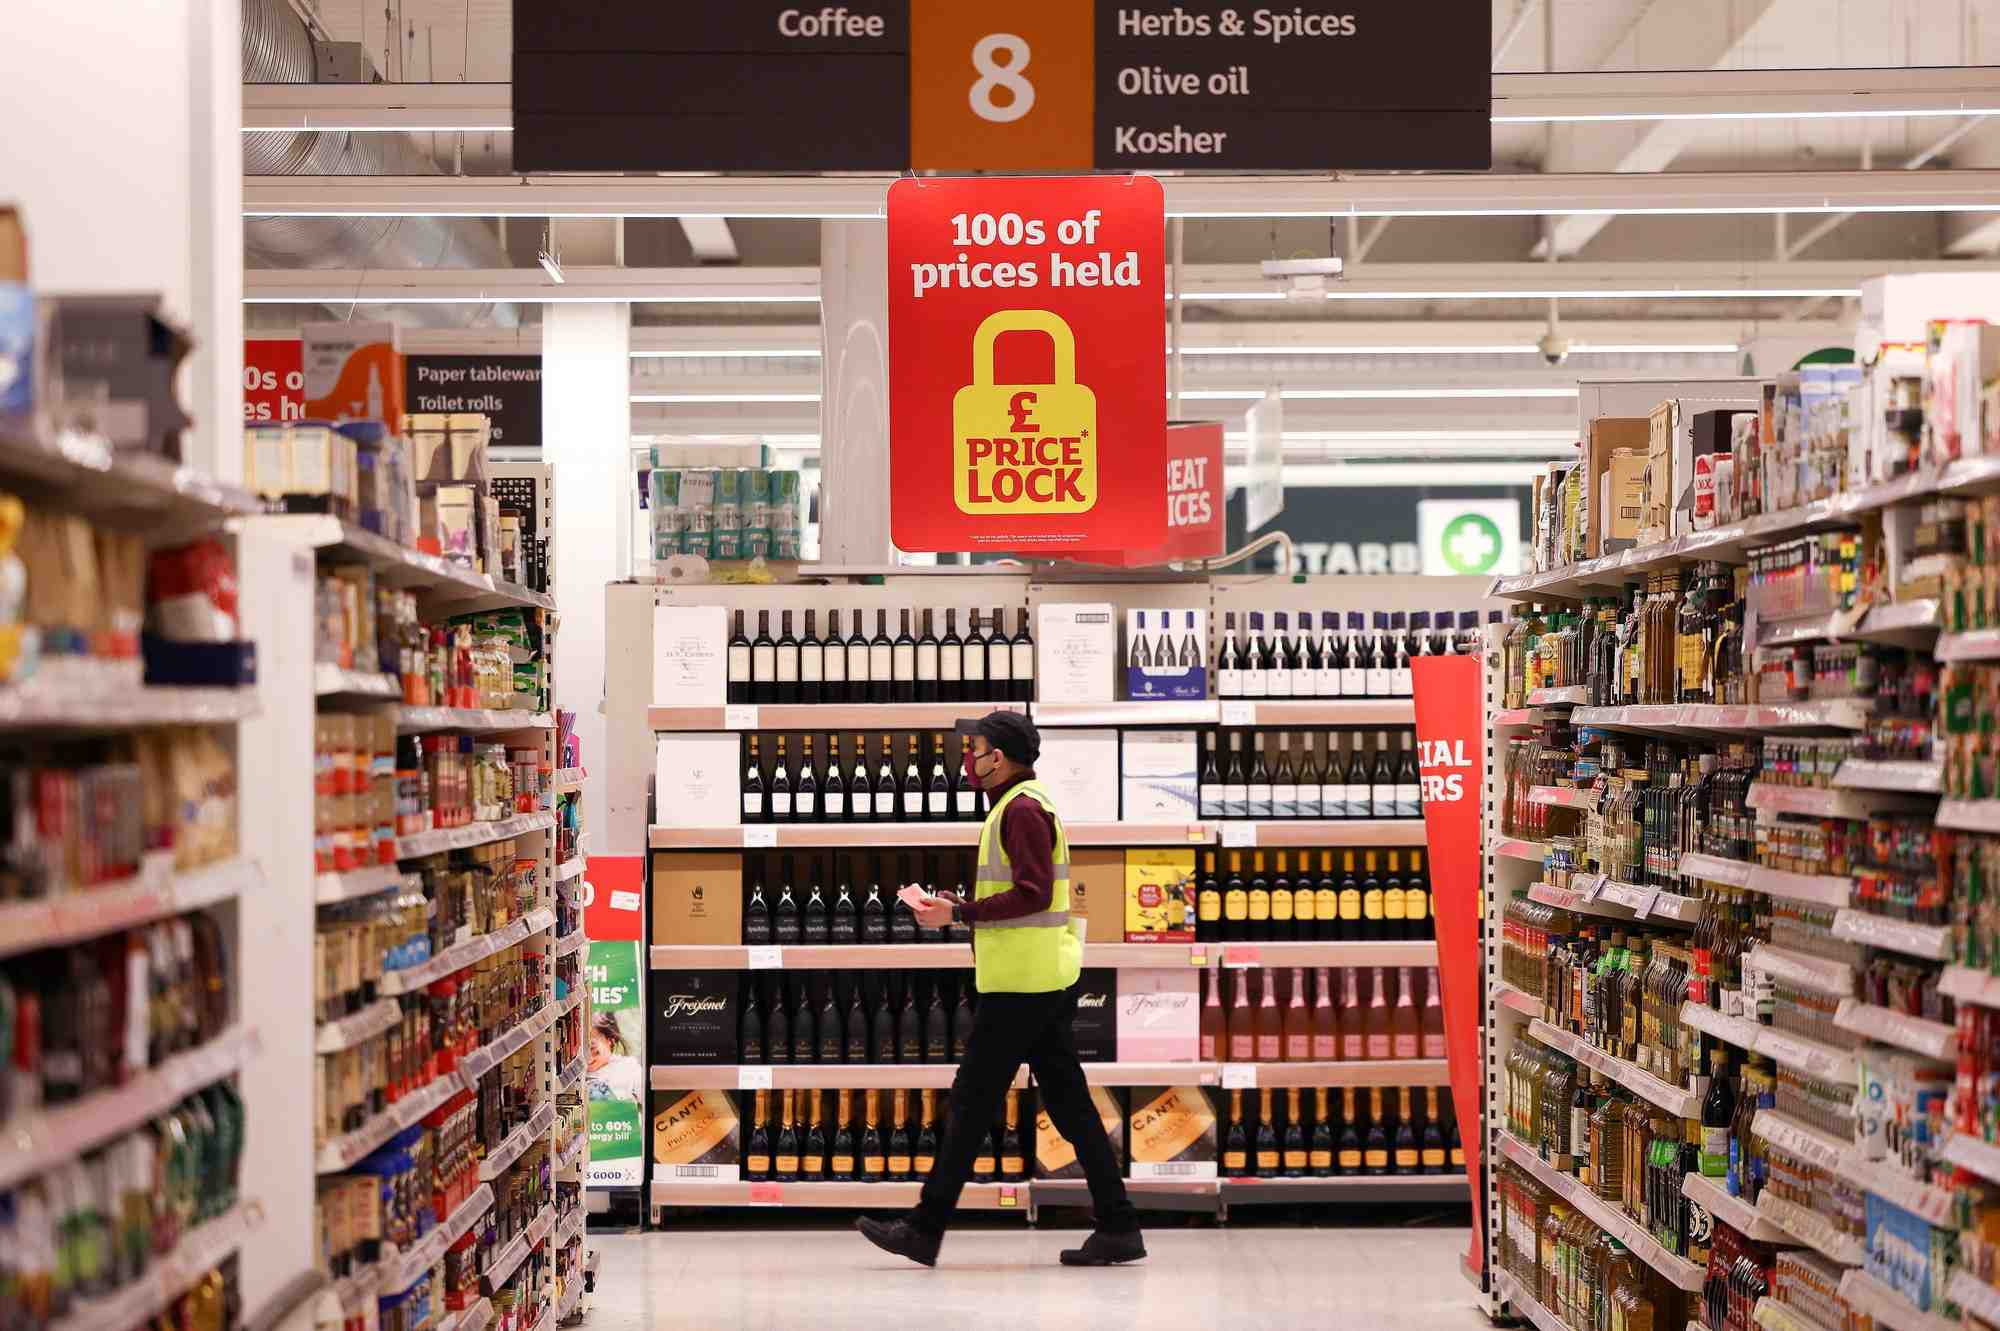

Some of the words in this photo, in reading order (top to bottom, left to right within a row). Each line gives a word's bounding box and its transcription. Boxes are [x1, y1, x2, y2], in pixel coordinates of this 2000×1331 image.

[778, 8, 884, 37] Coffee
[1118, 8, 1211, 36] Herbs
[1218, 9, 1246, 36] &
[1253, 8, 1356, 43] Spices
[968, 33, 1035, 122] 8
[1117, 66, 1200, 95] Olive
[1207, 66, 1250, 95] oil
[1115, 125, 1227, 153] Kosher
[951, 212, 1046, 246] 100s
[1057, 209, 1101, 245] of
[911, 253, 1038, 297] prices
[1051, 252, 1140, 287] held
[417, 366, 465, 385] Paper
[417, 395, 464, 411] Toilet
[467, 395, 503, 411] rolls
[1007, 391, 1040, 433] £
[967, 467, 1086, 504] LOCK
[1168, 456, 1209, 493] EAT
[664, 994, 728, 1018] Freixenet
[656, 1095, 705, 1132] CANTI
[1132, 1094, 1182, 1131] CANTI
[593, 1171, 622, 1180] GOOD
